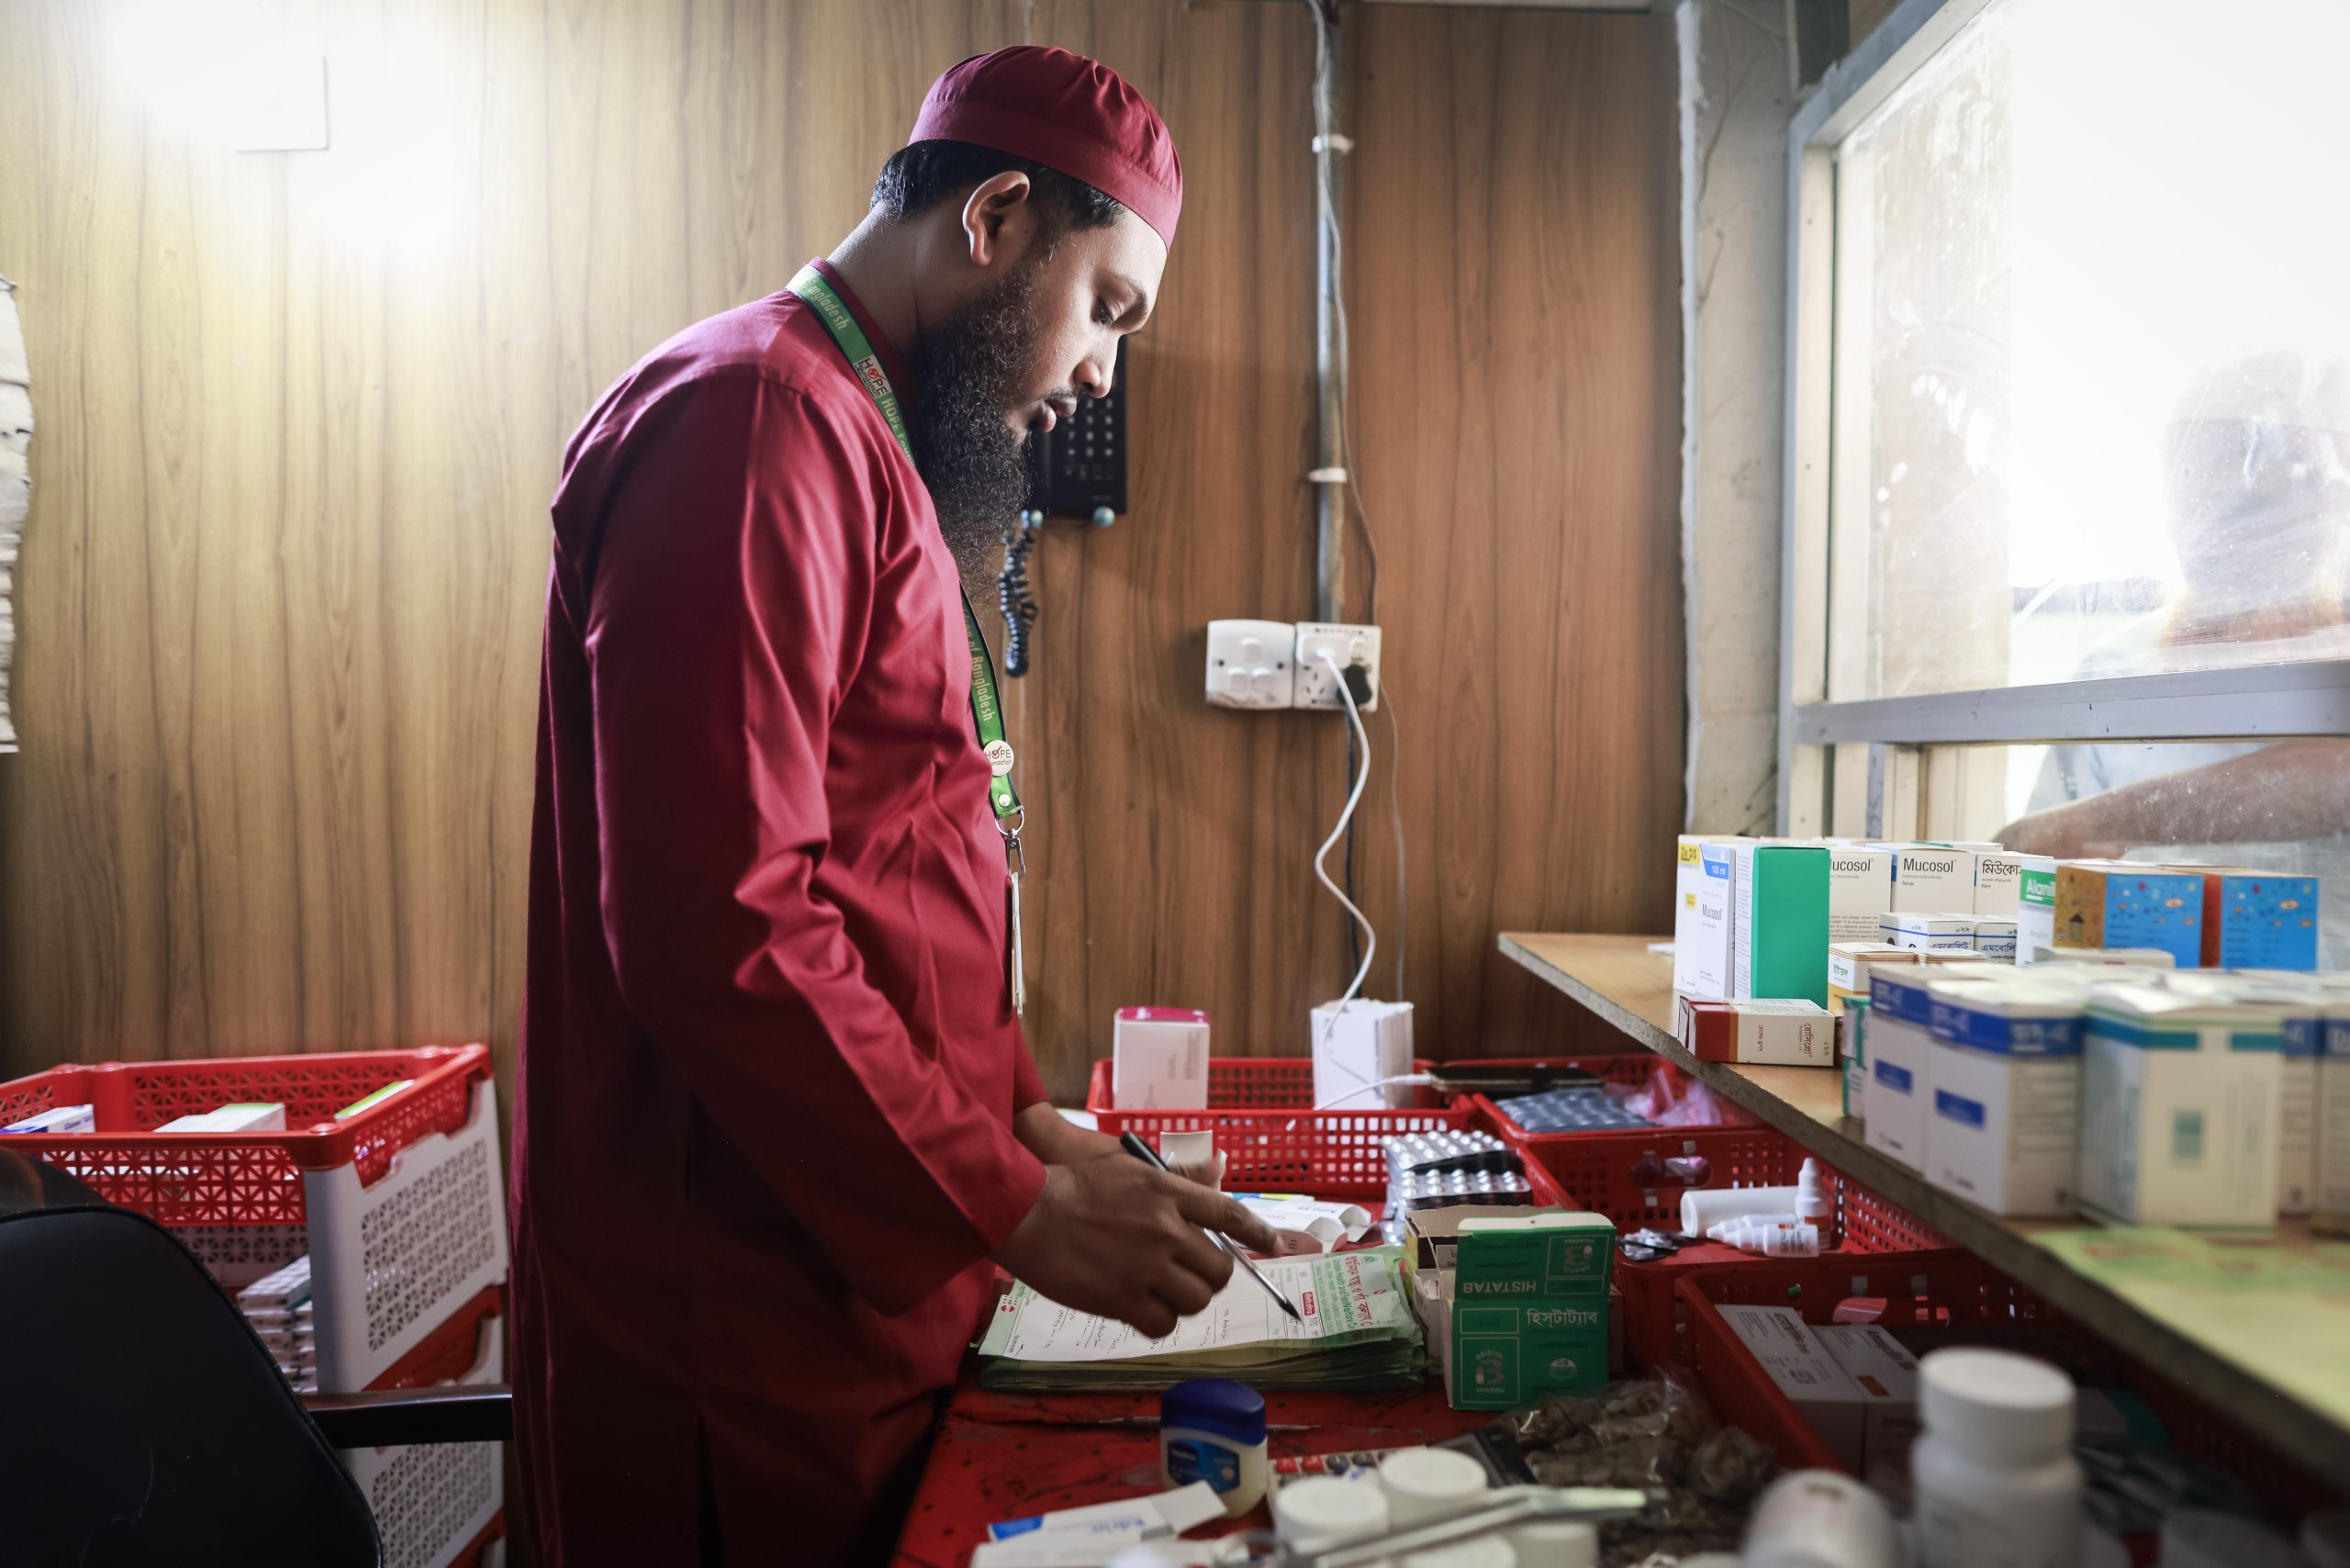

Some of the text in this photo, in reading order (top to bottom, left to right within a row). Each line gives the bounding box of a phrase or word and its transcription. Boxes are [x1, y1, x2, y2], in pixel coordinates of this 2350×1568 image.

[804, 276, 849, 330] Bangladesh
[857, 357, 889, 398] HOPE
[880, 397, 902, 431] HOPE
[971, 655, 996, 722] Bangladesh
[1830, 857, 1871, 872] ucosol
[1903, 857, 1954, 873] Mucosol
[1702, 903, 1723, 922] Mucosol
[1462, 1282, 1537, 1294] HISTATAB
